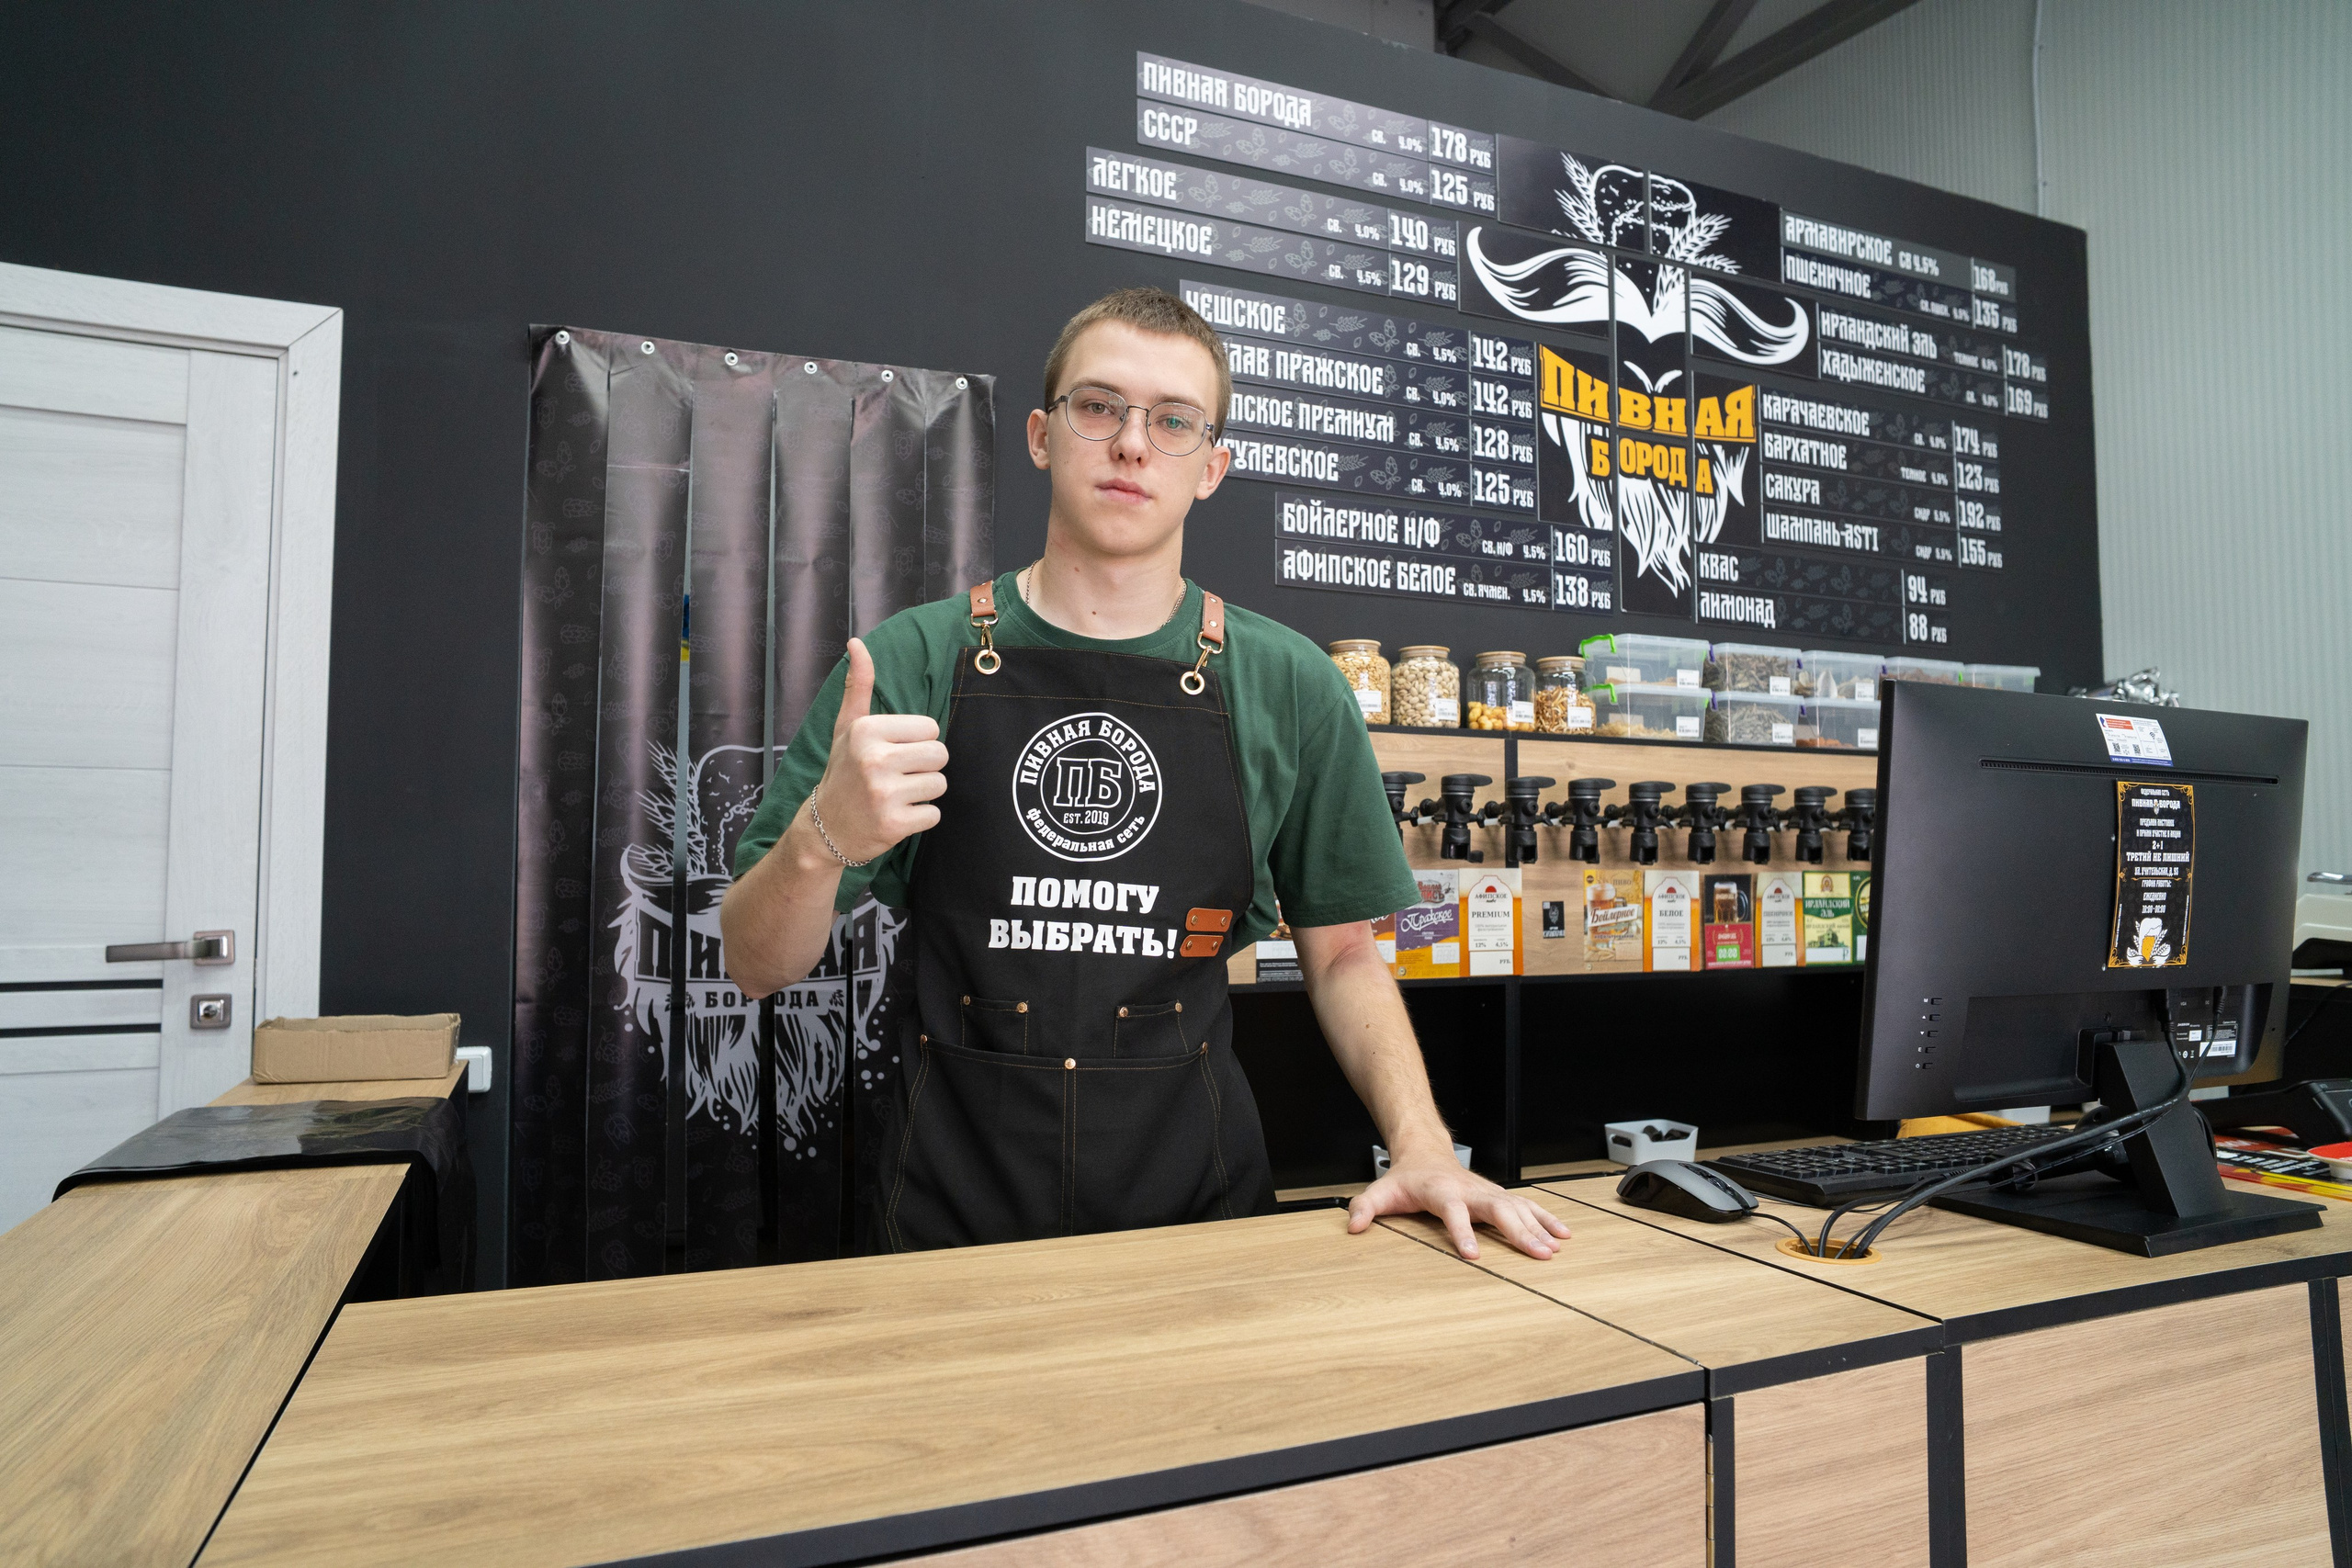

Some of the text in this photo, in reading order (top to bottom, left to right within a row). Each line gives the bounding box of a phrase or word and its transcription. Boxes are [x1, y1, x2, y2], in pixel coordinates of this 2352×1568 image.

[1143, 62, 1491, 168] ПИВНАЯ БОРОДА СВ. 4.0% 178 РУБ
[1144, 109, 1495, 211] СССР СВ. 4.0% 125 РУБ
[1093, 157, 1456, 256] ЛЕГКОЕ СВ. 4.0% 140 РУБ
[1091, 205, 1456, 300] НЕМЕЦКОЕ СВ. 4.5% 129 РУБ
[1785, 215, 1893, 266] АРМАВИРСКОЕ
[1974, 265, 1996, 293] 168
[1786, 254, 1871, 299] ПШЕНИЧНОЕ
[1975, 299, 1999, 329] 135
[1186, 290, 1532, 376] ЧЕШСКОЕ СВ. 4.5% 142 РУБ
[1821, 310, 1909, 354] ИРЛАНДСКИЙ
[1912, 332, 1938, 360] ЭЛЬ
[2007, 349, 2030, 378] 178
[1224, 342, 1532, 419] ЛАВ ПРАЖСКОЕ СВ. 4.0% 142 РУБ
[1540, 343, 1757, 443] ПИВНАЯ
[1822, 349, 1926, 394] ХАДЫЖЕНСКОЕ
[2007, 386, 2032, 415] 169
[1227, 393, 1533, 464] ПСКОЕ ПРЕМИУМ СВ. 4.5% 128 РУБ
[1762, 393, 1871, 436] КАРАЧАЕВСКОЕ
[1955, 425, 1980, 456] 174
[1216, 437, 1533, 508] УЛЕВСКОЕ СВ. 4.0% 125 РУБ
[1591, 437, 1713, 494] БОРОДА
[1764, 432, 1848, 470] БАРХАТНОЕ
[1957, 462, 1983, 491] 123
[1283, 500, 1398, 544] БОЙЛЕРНОЕ
[1404, 516, 1441, 548] Н/Ф
[1523, 545, 1545, 560] 4.5%
[1555, 531, 1589, 565] 160
[1591, 548, 1611, 568] РУБ
[1765, 472, 1820, 505] САКУРА
[1959, 500, 1984, 529] 192
[1283, 549, 1391, 589] АФИПСКОЕ
[1396, 561, 1455, 595] БЕЛОЕ
[1523, 588, 1545, 604] 4.5%
[1555, 574, 1589, 607] 138
[1591, 591, 1611, 609] РУБ
[1700, 551, 1946, 606] КВАС 94 РУБ
[1961, 536, 1986, 566] 155
[1700, 592, 1947, 643] ЛИМОНАД 88 РУБ
[1020, 720, 1156, 793] ПИВНАЯ БОРОДА
[1053, 757, 1123, 808] ПБ
[1026, 807, 1146, 852] Федеральная сеть
[2126, 851, 2189, 863] ТРЕТИЙ НЕ ЛИШНИЙ
[2152, 840, 2164, 850] 2+1
[1011, 876, 1159, 914] ПОМОГУ
[635, 905, 880, 980] ПИЯ
[989, 919, 1178, 959] ВЫБРАТЬ!
